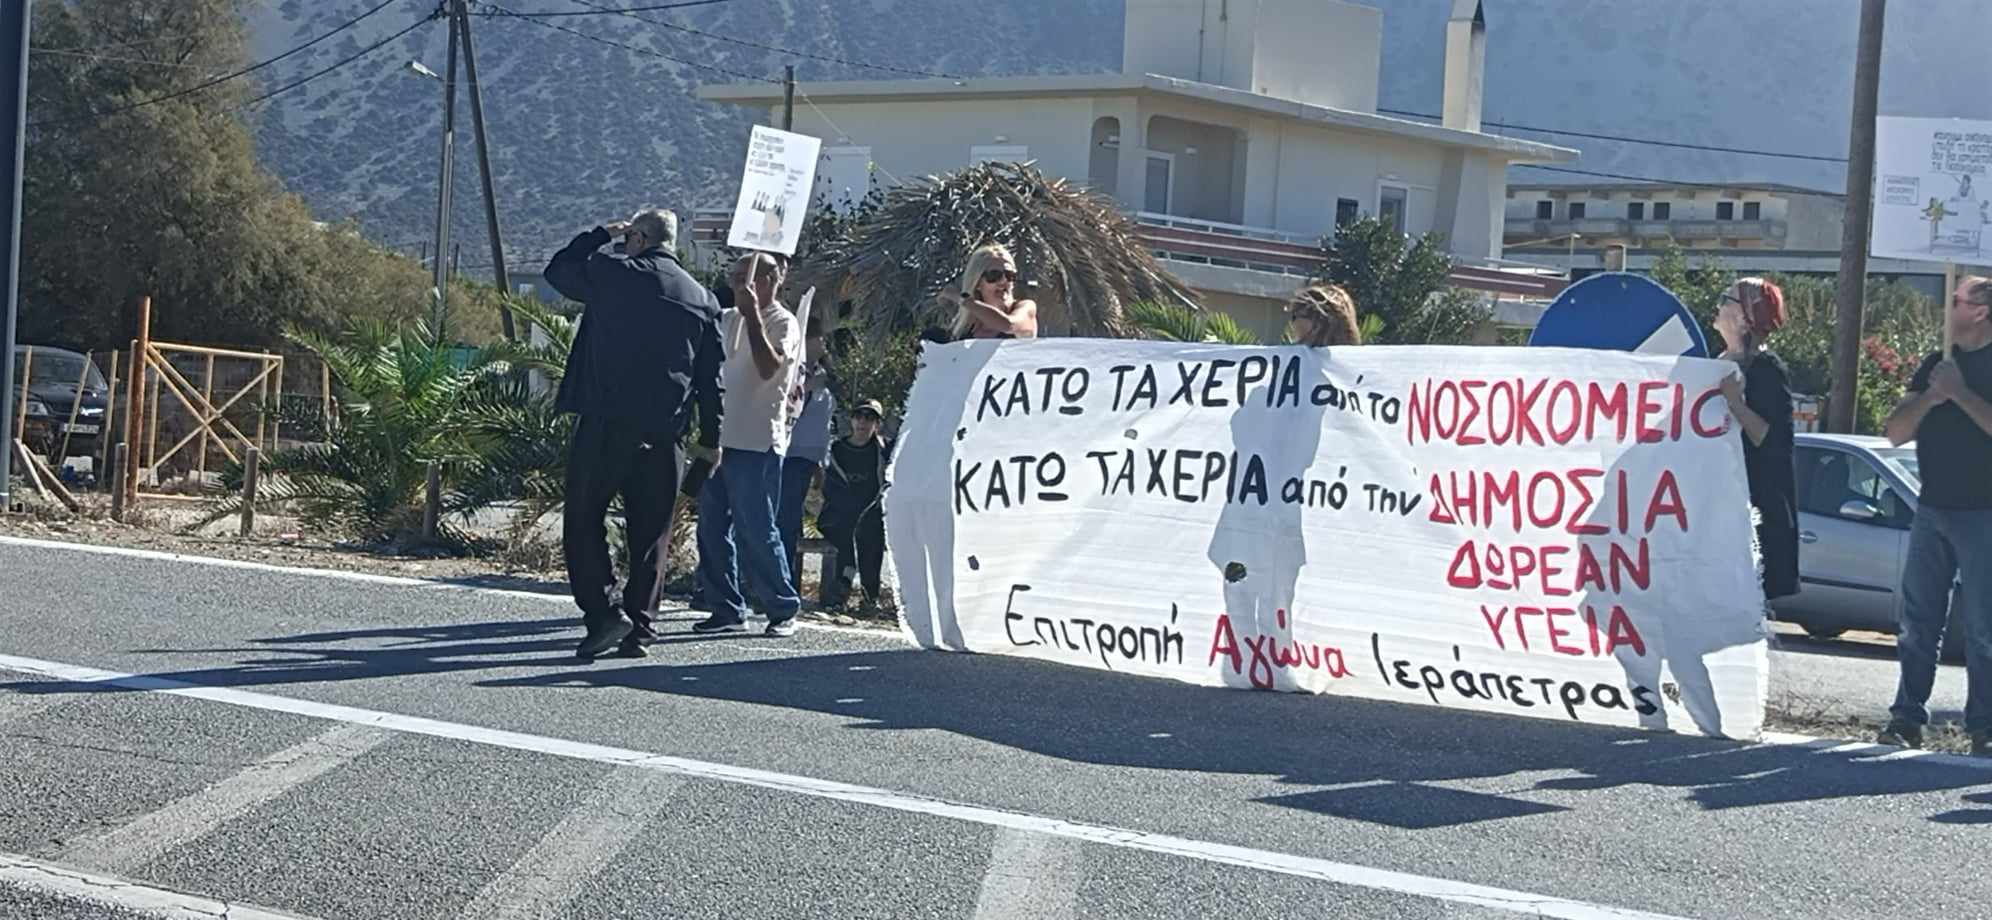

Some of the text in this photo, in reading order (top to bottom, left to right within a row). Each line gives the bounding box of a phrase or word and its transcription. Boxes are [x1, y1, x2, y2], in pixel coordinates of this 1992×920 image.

[977, 366, 1090, 422] ΚΑΤΩ
[1109, 363, 1158, 412] ΤΑ
[1168, 355, 1300, 409] ΧΕΡΙΑ
[1367, 391, 1401, 425] το
[954, 448, 1689, 535] ΚΑΤΩ ΤΑ ΧΕΡΙΑ από την ΔΗΜΟΣΙΑ
[1446, 537, 1651, 597] ΔΩΡΕΑΝ
[1004, 583, 1659, 721] Επιτροπή Αγώνα Ιεράπετρας
[1479, 604, 1647, 657] ΥΓΕΙΑ
